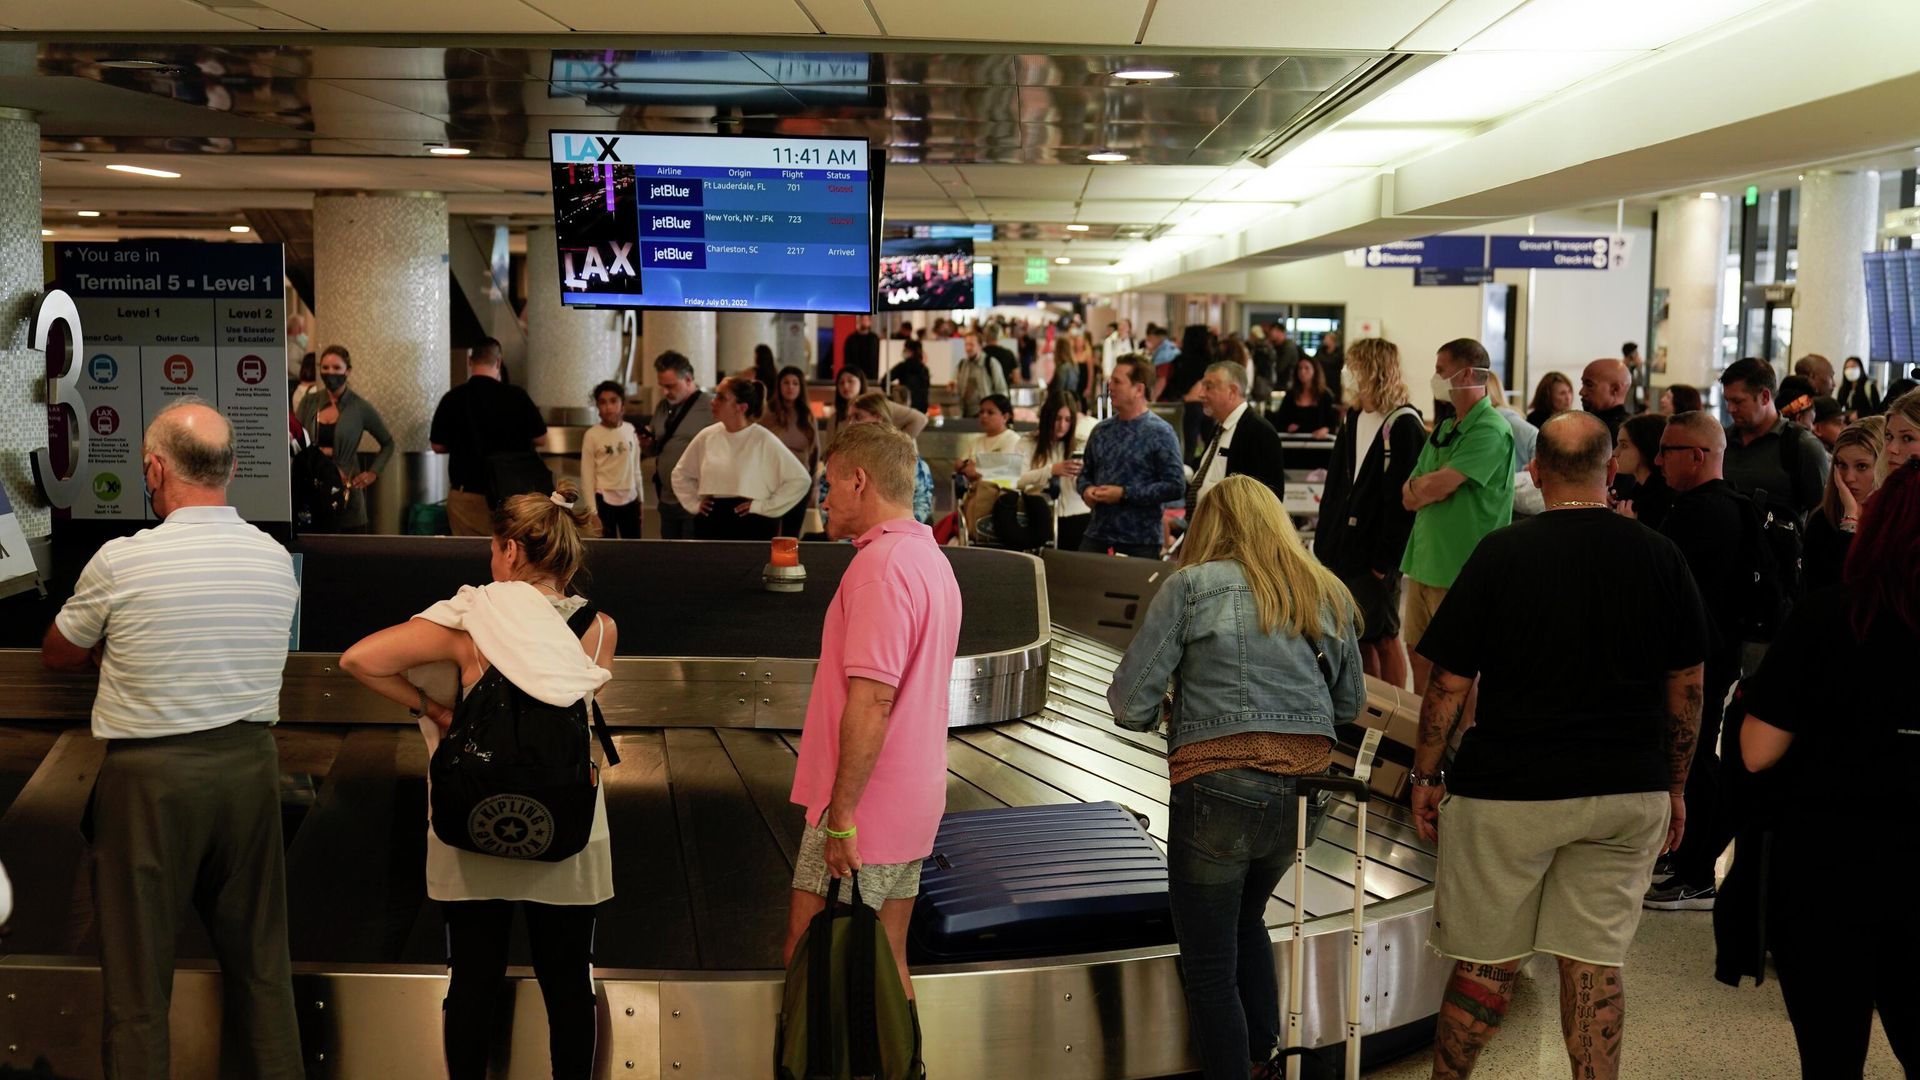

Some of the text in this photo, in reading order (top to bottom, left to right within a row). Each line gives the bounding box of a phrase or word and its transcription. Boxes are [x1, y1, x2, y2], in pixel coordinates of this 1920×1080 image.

[564, 136, 621, 162] LAX
[773, 147, 856, 165] 11:41 AM
[657, 167, 851, 180] Airline Origin Flight Status
[650, 184, 689, 199] jetBlue
[703, 182, 712, 190] Ft
[712, 182, 756, 192] Lauderdale,
[757, 183, 766, 191] FL
[787, 183, 800, 192] 701
[651, 216, 690, 231] jetBlue
[705, 213, 721, 222] New
[722, 213, 742, 223] York,
[743, 214, 753, 222] NY
[760, 214, 773, 223] JFK
[788, 215, 802, 223] 723
[654, 245, 855, 262] jetBlue Charleston, SC 2217 Arrived
[1519, 240, 1593, 252] Ground Transport
[77, 247, 160, 262] You are in
[1382, 254, 1422, 265] Elevators
[1554, 254, 1592, 265] Check-In
[564, 240, 636, 290] LAX
[76, 274, 272, 291] Terminal 5 Level 1
[684, 298, 704, 306] Friday
[888, 286, 919, 305] LAX
[117, 307, 160, 318] Level 1
[228, 308, 273, 319] Level 2
[226, 326, 276, 334] Use Elevator
[103, 334, 123, 342] Curb
[238, 335, 275, 343] Escalator
[28, 289, 88, 510] 3
[480, 800, 544, 826] KIPLING
